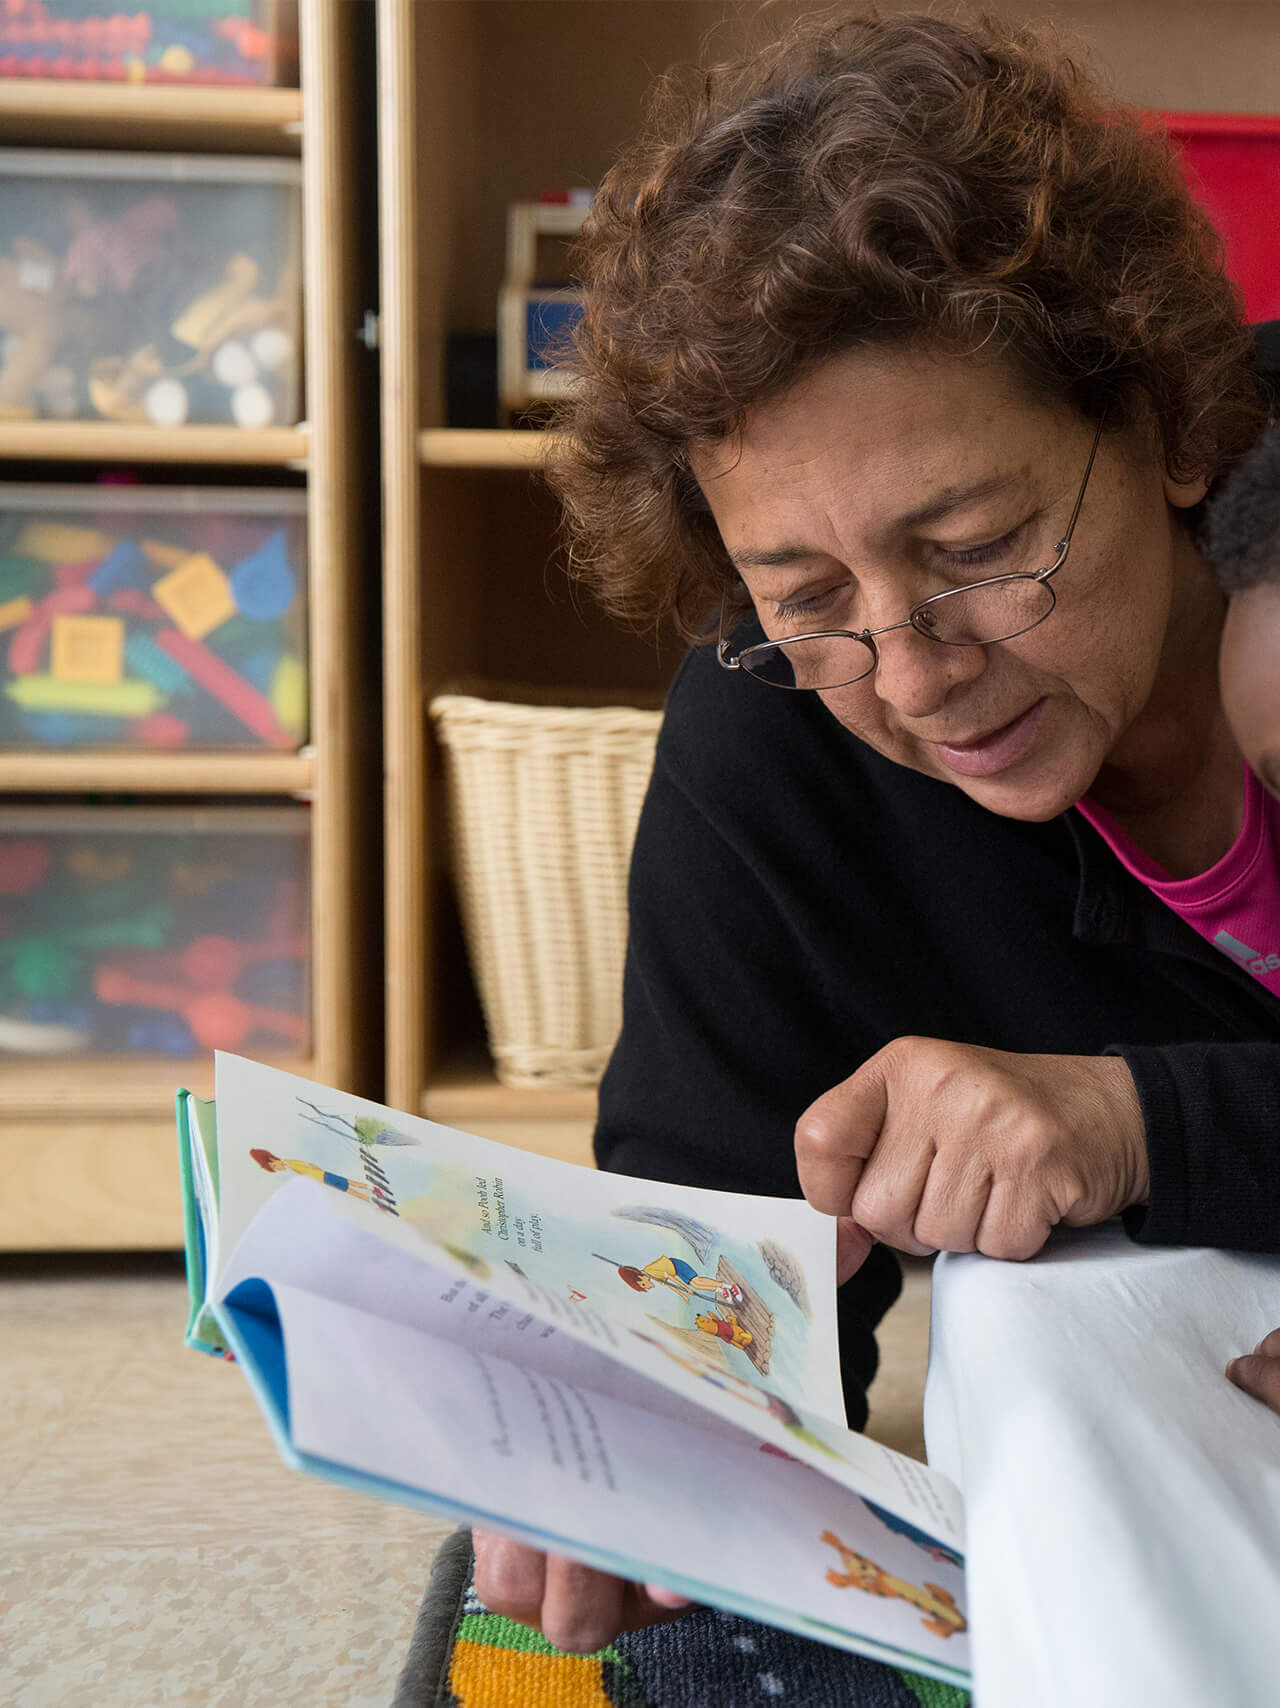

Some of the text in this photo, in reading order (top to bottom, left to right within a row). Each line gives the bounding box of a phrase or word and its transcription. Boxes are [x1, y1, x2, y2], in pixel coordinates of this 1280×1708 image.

[475, 1176, 487, 1190] led
[477, 1191, 489, 1209] Pooh
[493, 1177, 509, 1240] Christopher Robin
[480, 1218, 493, 1235] And
[513, 1218, 526, 1231] day
[530, 1239, 544, 1253] full
